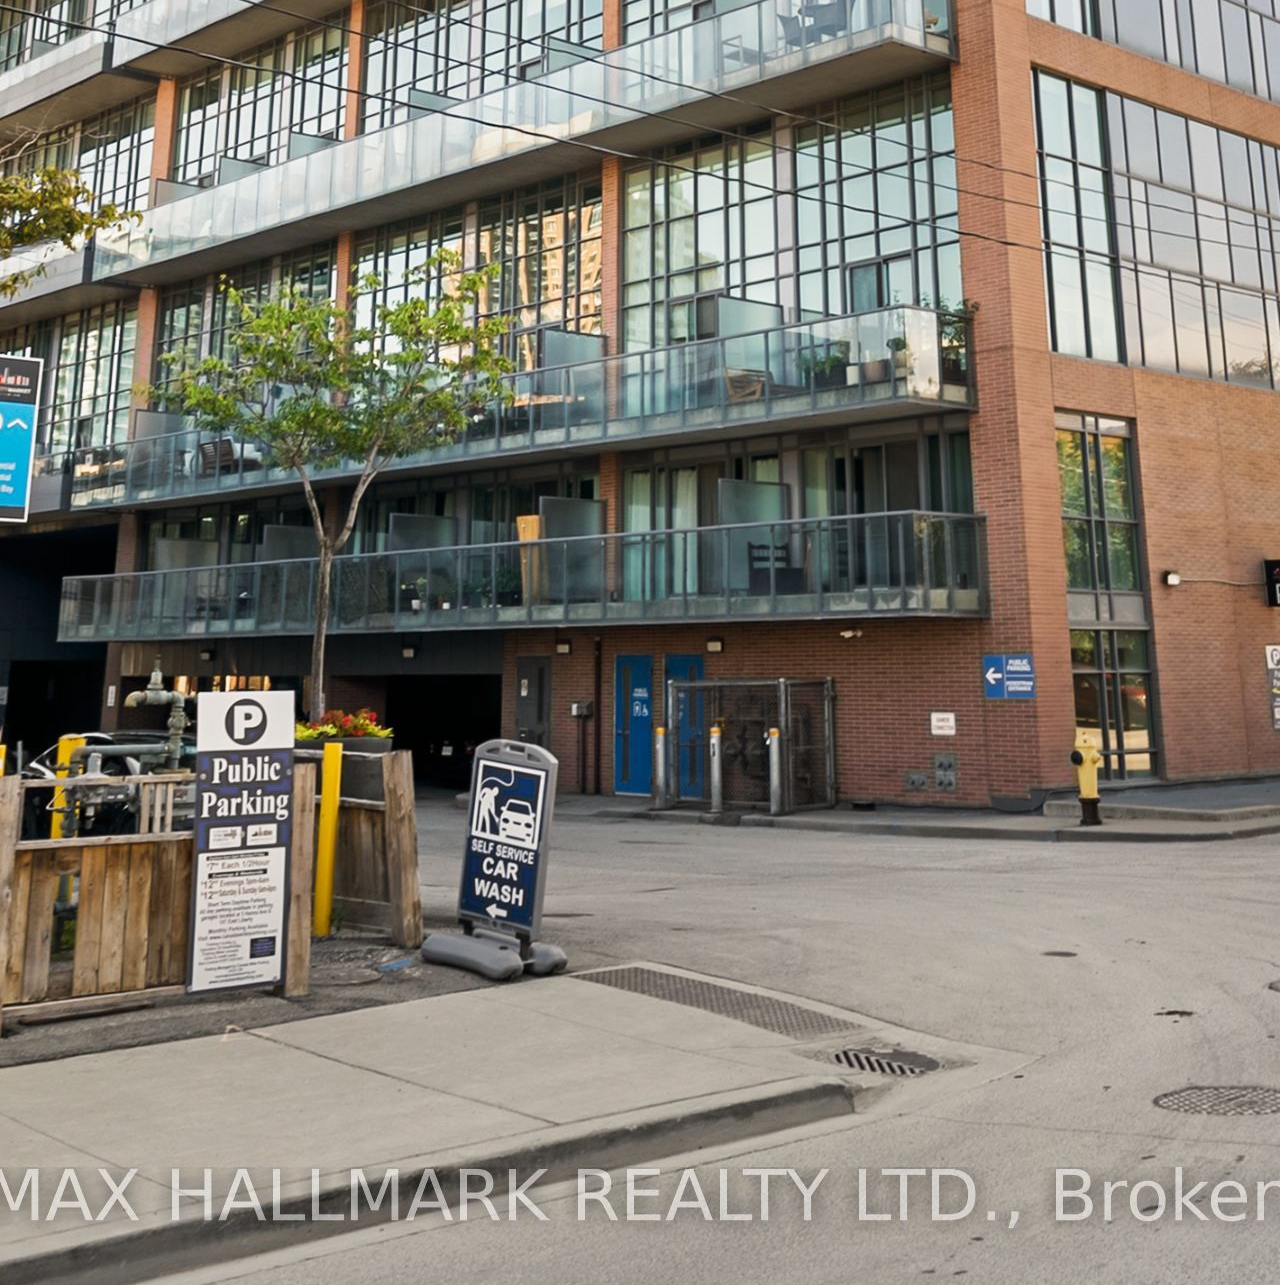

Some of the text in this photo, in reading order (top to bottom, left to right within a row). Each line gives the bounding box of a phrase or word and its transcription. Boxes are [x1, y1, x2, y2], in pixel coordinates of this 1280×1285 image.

[1, 485, 14, 494] Bay
[233, 705, 263, 740] P
[211, 756, 281, 784] Public
[200, 789, 290, 821] Parking
[471, 838, 535, 865] SELF SERVICE
[483, 856, 518, 881] CAR
[474, 877, 524, 907] WASH
